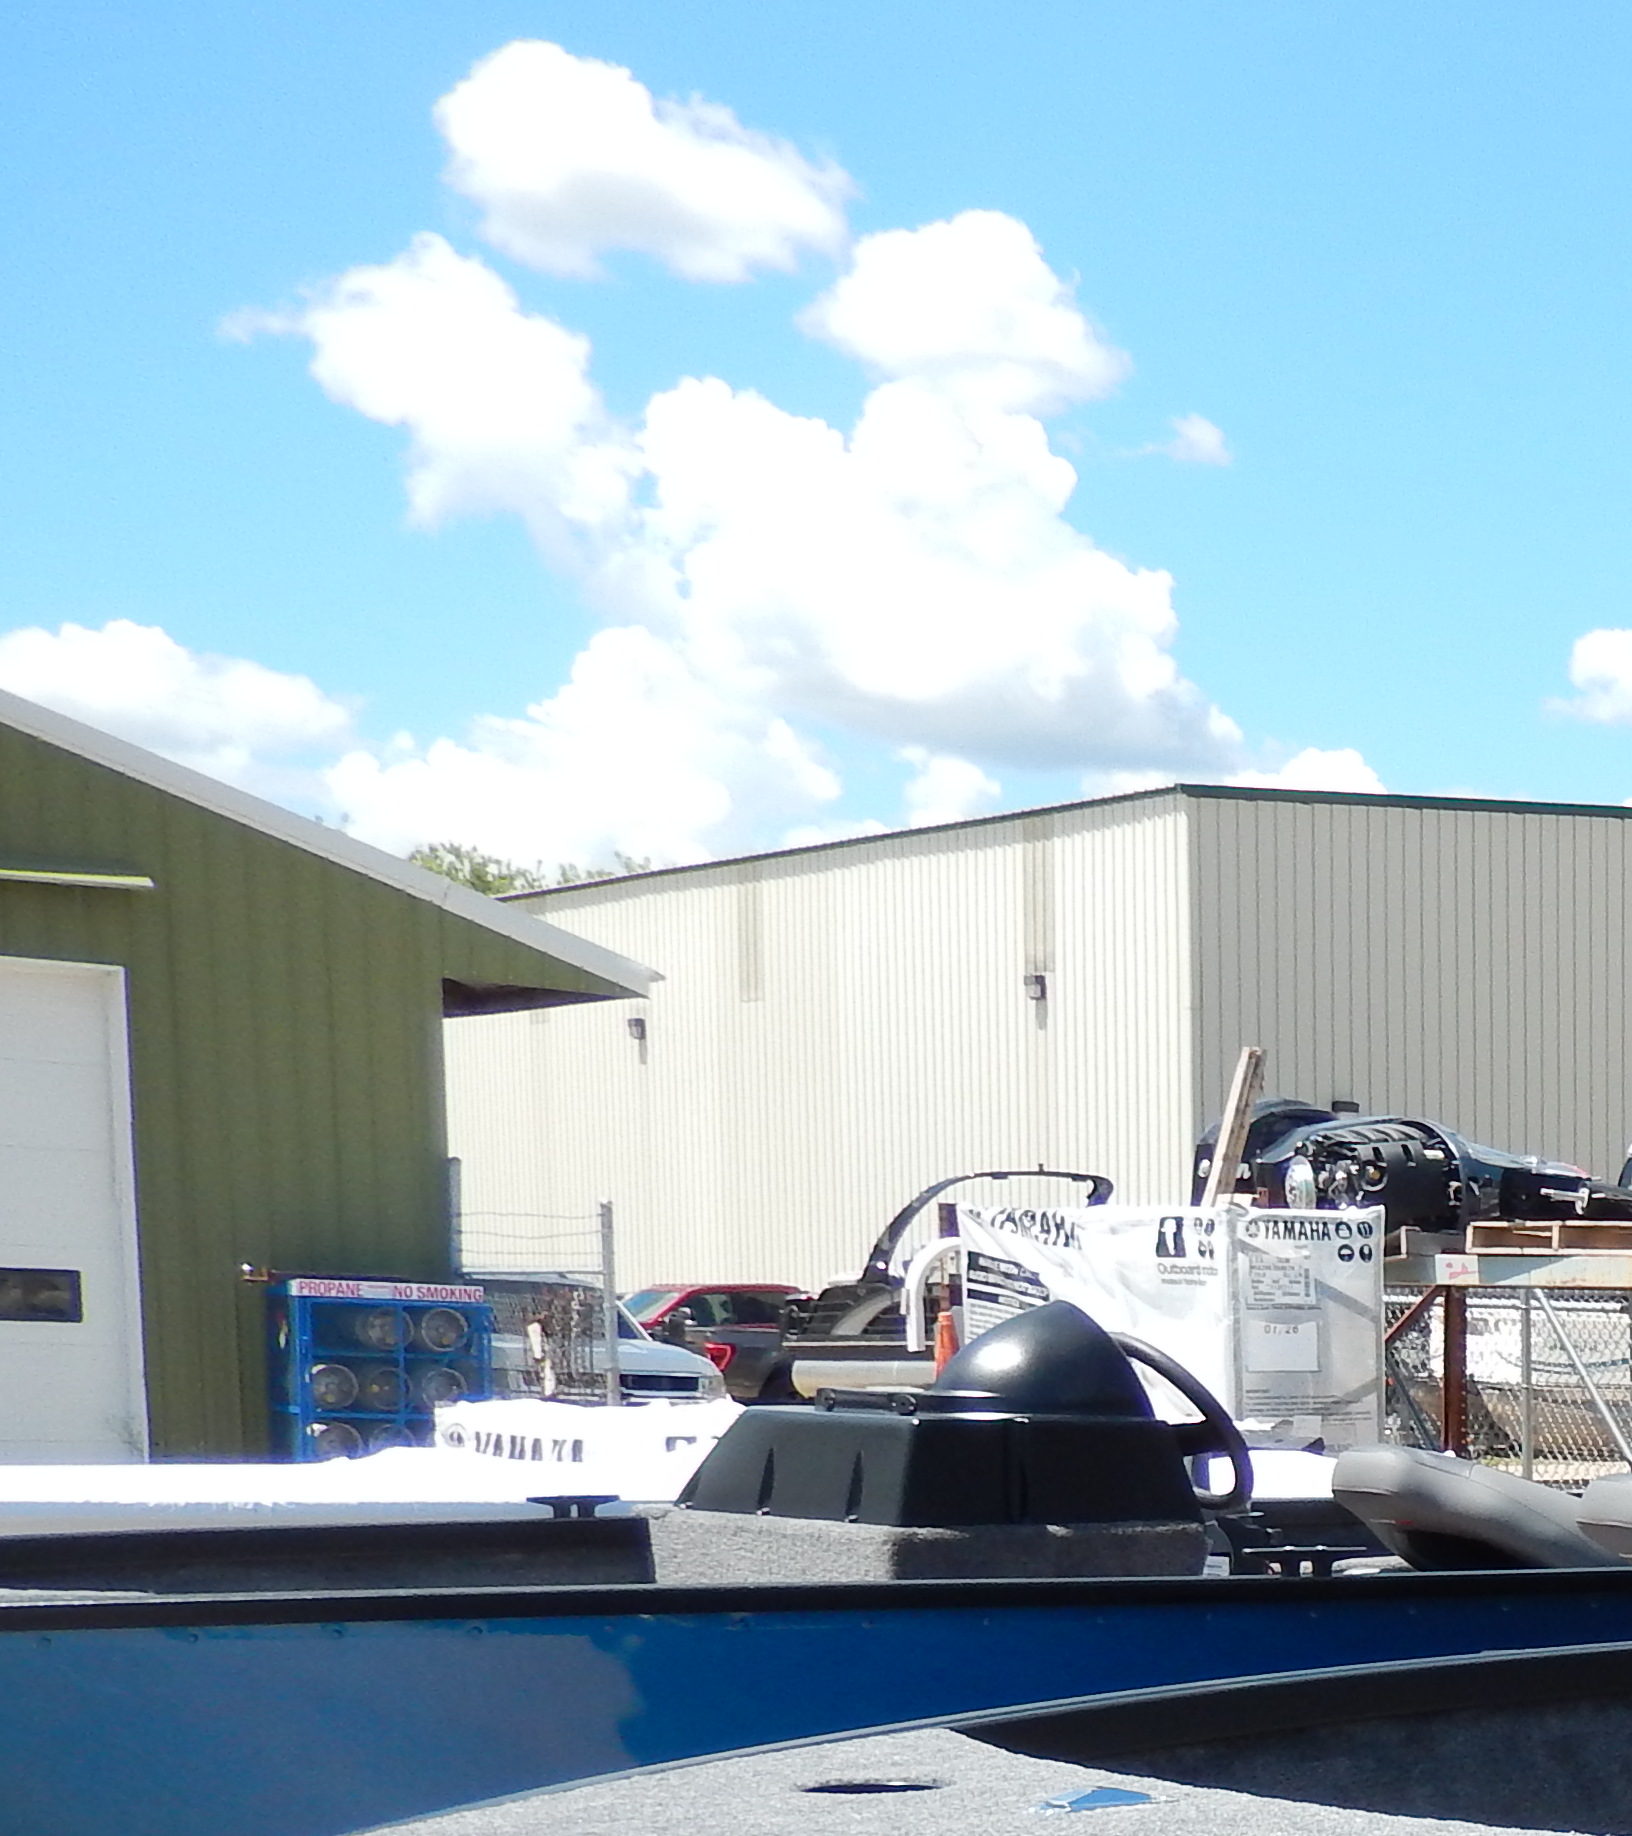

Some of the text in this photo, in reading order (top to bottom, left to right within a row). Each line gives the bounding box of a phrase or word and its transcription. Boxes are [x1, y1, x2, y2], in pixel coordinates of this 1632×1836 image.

[1264, 1219, 1332, 1241] YAMAHA
[299, 1280, 483, 1302] PROPANE NO SMOKING
